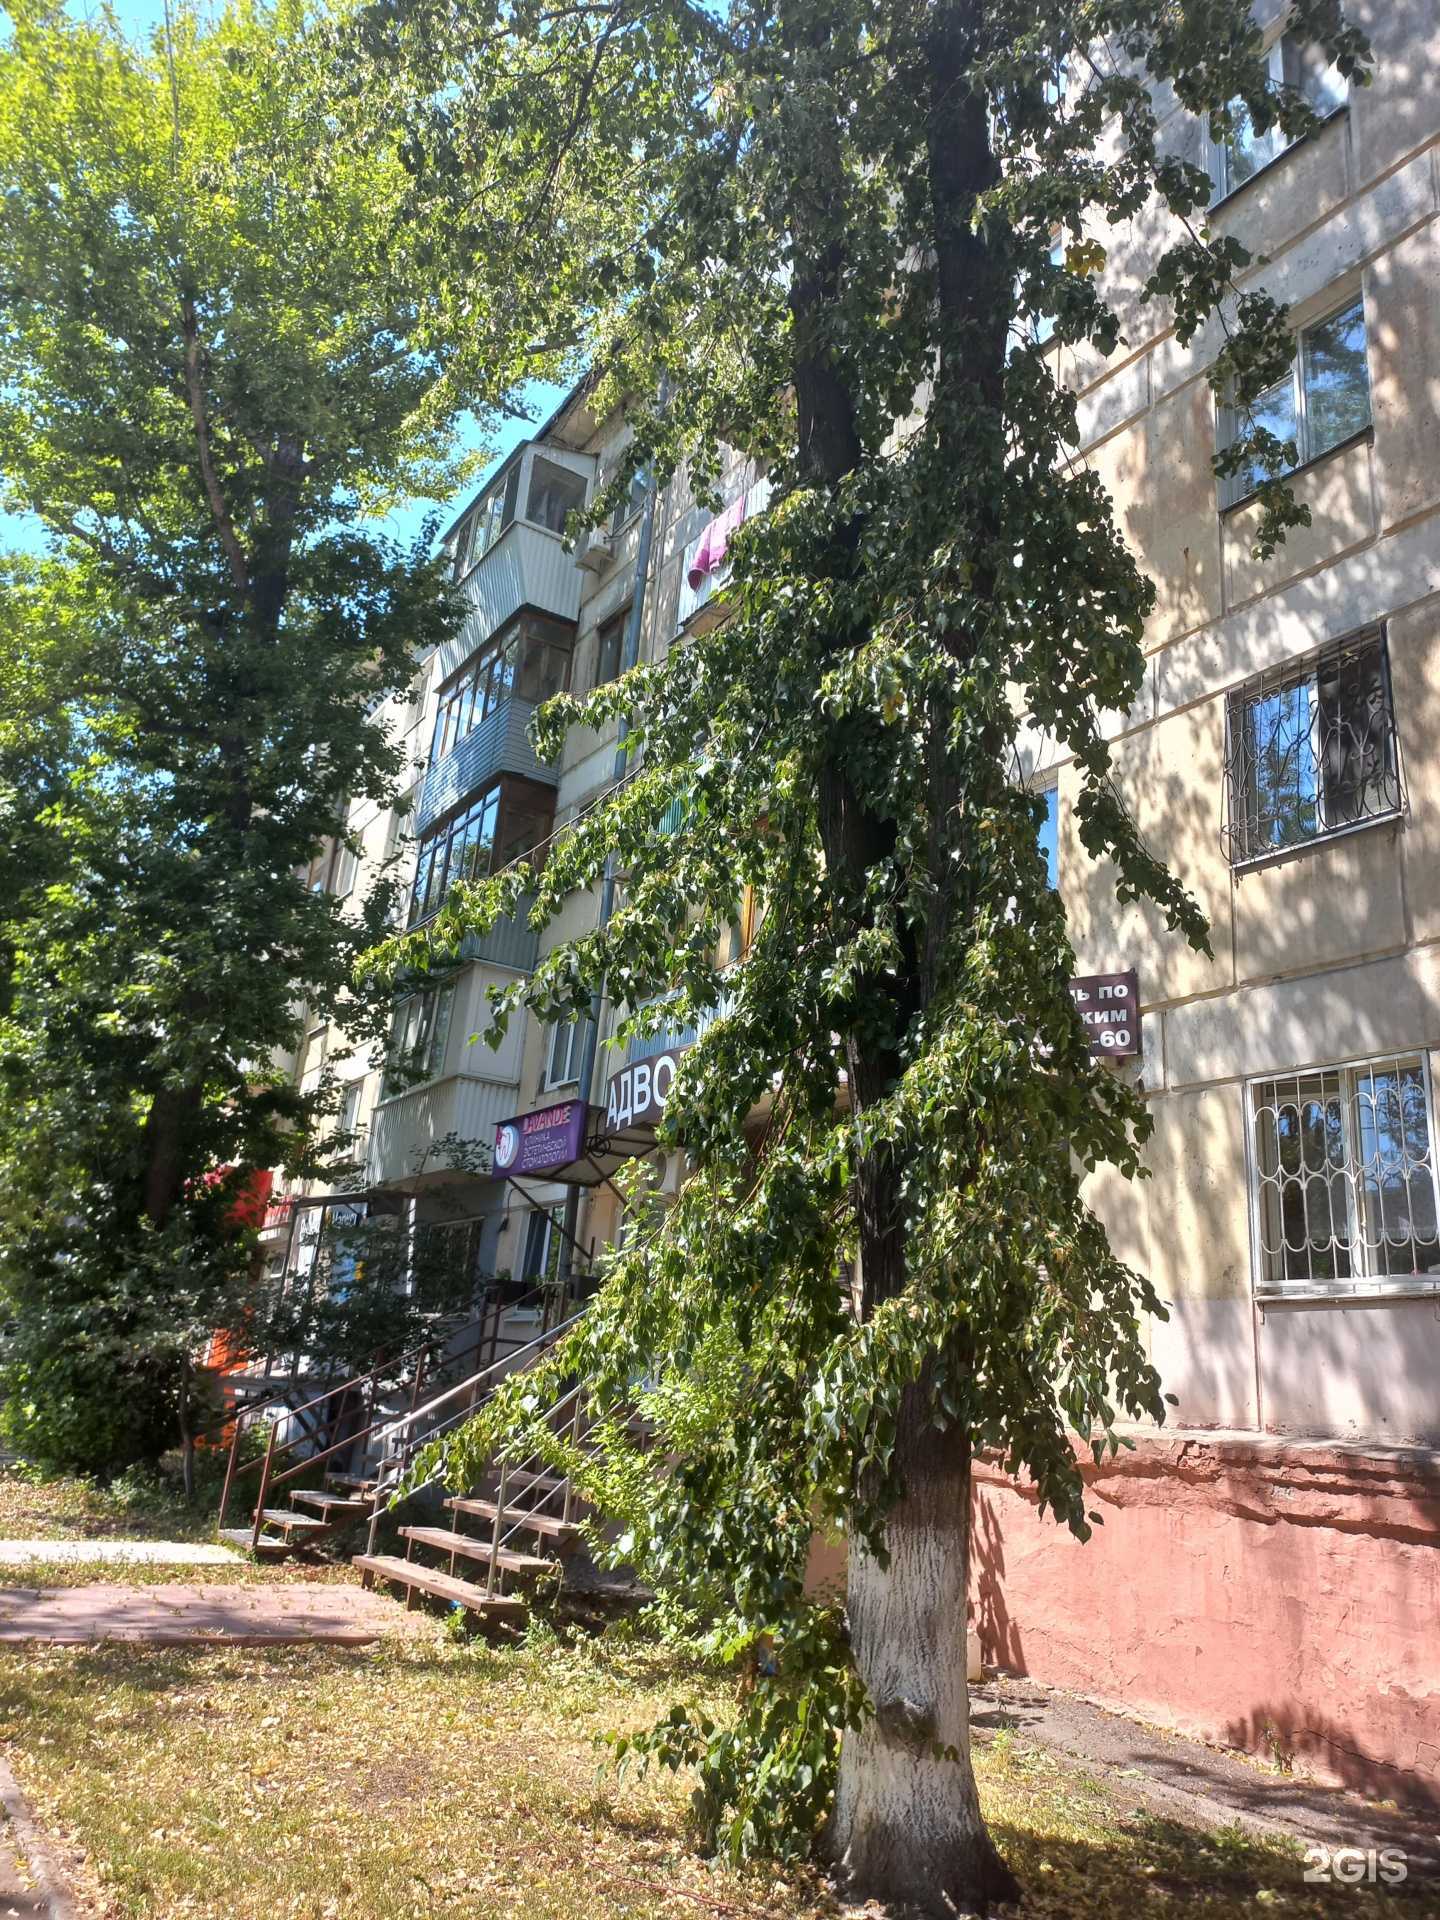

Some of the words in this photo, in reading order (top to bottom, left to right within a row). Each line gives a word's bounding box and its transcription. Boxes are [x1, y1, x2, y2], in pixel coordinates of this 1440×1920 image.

[1080, 1009, 1127, 1025] ким
[1092, 1029, 1131, 1048] -60
[606, 1055, 678, 1131] АДВО
